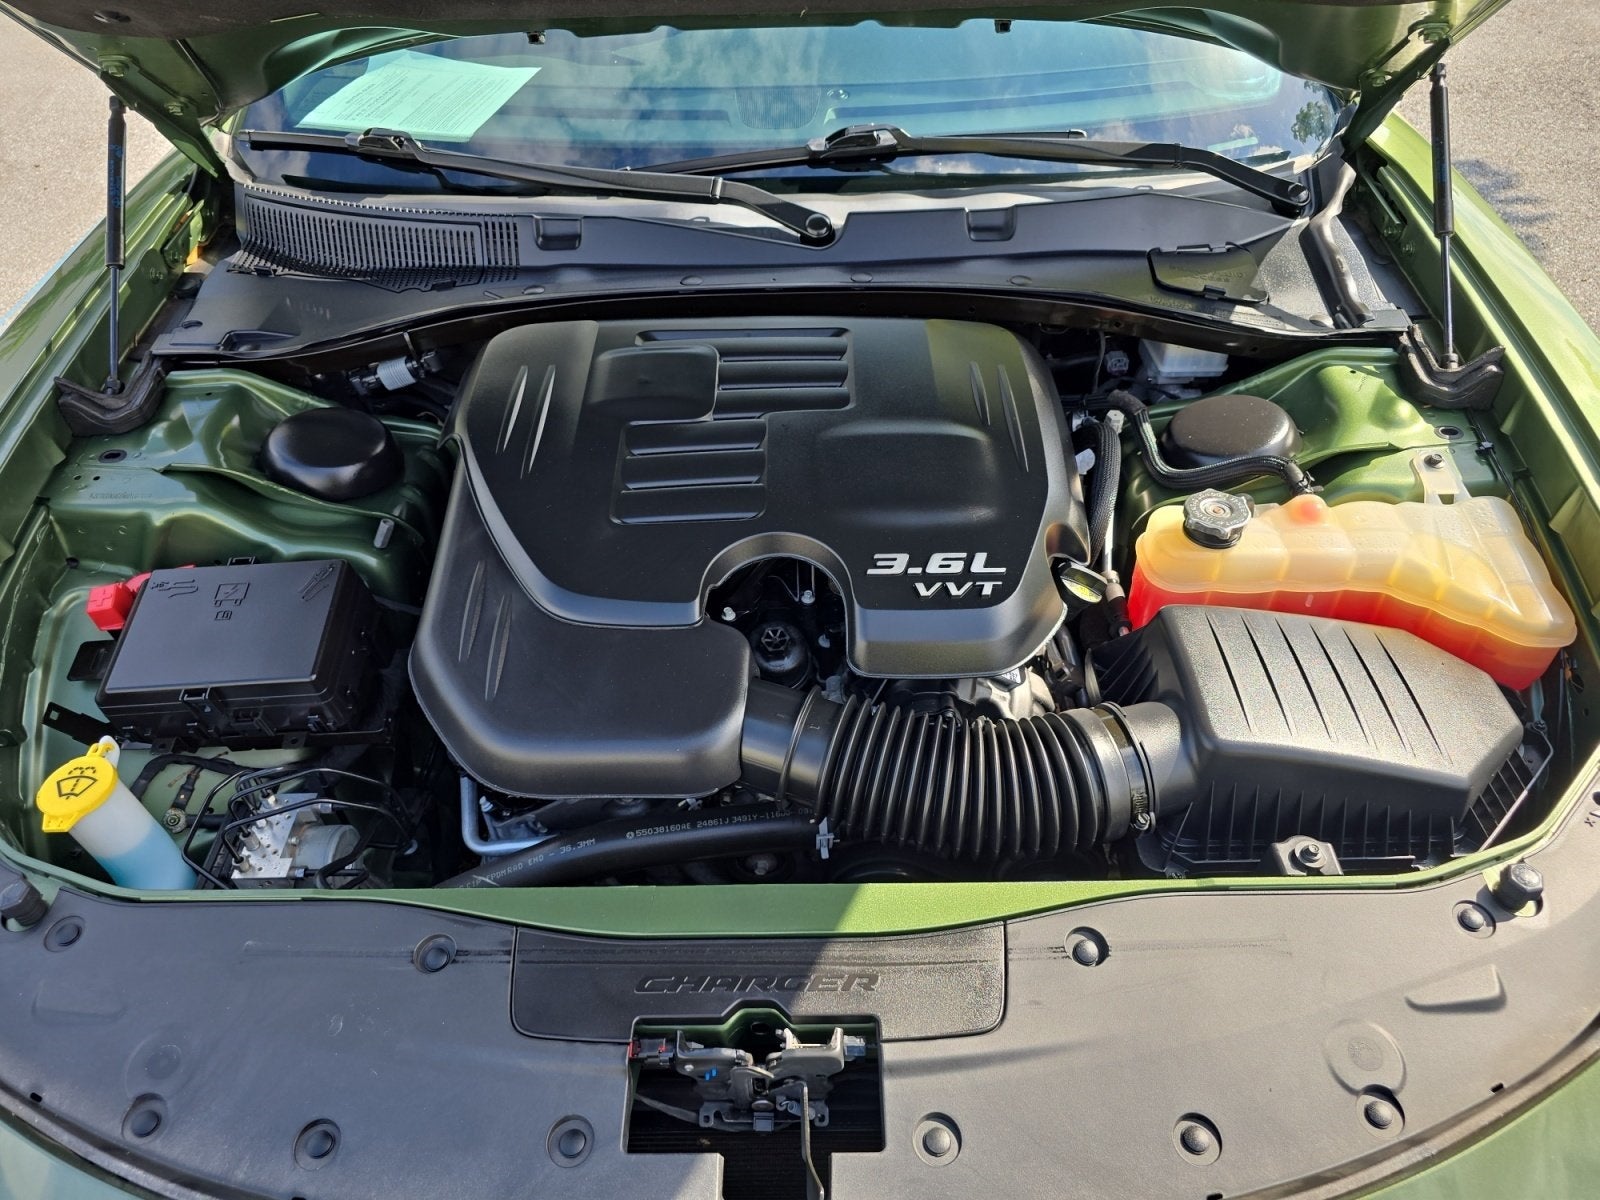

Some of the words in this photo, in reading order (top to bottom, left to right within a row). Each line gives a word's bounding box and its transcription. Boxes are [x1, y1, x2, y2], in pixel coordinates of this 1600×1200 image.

[866, 552, 1007, 575] 3.6L
[913, 581, 1003, 599] VVT
[634, 973, 881, 994] CHARGER
